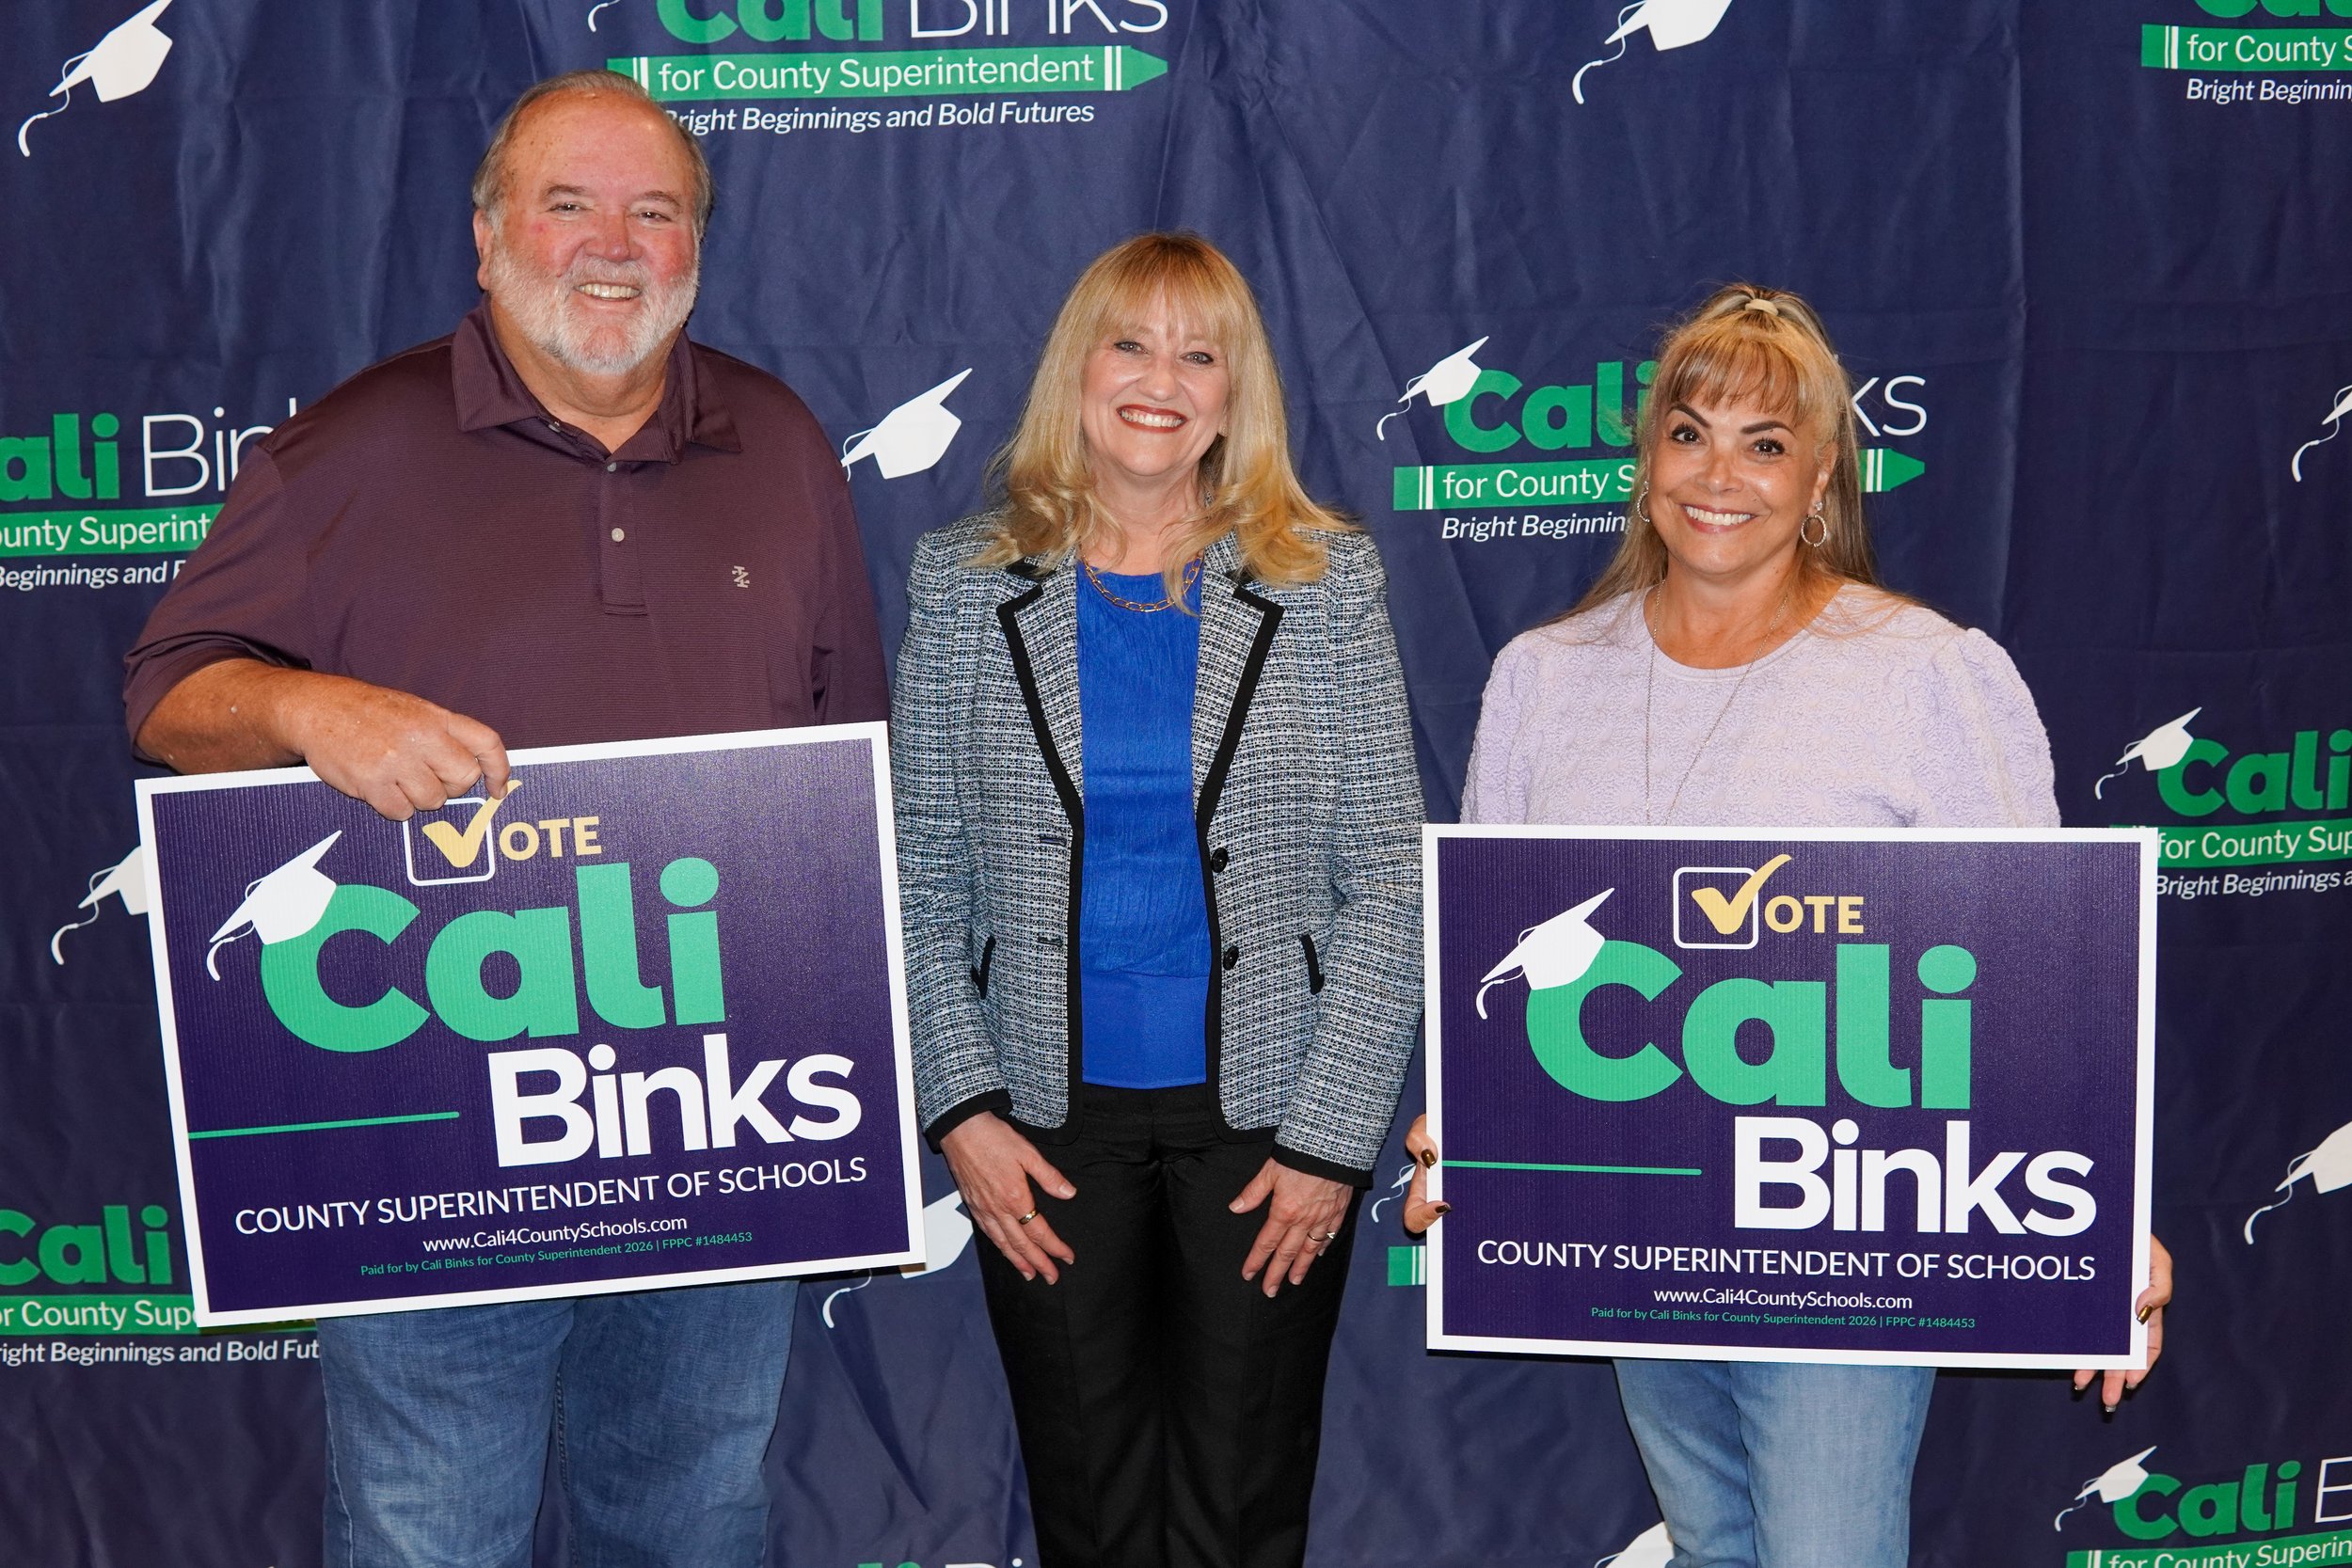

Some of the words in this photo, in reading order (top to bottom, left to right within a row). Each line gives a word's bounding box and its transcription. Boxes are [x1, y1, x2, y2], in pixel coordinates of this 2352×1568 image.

[2186, 34, 2228, 61] for
[2235, 35, 2337, 67] County
[659, 63, 705, 91] for
[713, 60, 831, 94] County
[840, 54, 1094, 92] Superintendent
[2186, 78, 2255, 104] Bright
[2259, 79, 2352, 104] Beginnin
[742, 107, 881, 134] Beginnings
[886, 104, 932, 127] and
[938, 103, 994, 125] Bold
[1000, 102, 1094, 123] Futures
[1442, 472, 1488, 499] for
[1496, 469, 1609, 499] County
[0, 519, 72, 551] unty
[1441, 516, 1516, 543] Bright
[1521, 512, 1632, 540] Beginnin
[123, 561, 167, 584] and
[2157, 729, 2352, 816] Cali
[2157, 832, 2196, 859] for
[2201, 829, 2301, 858] County
[2223, 869, 2341, 896] Beginnings
[261, 857, 725, 1053] Cali
[1526, 940, 1977, 1109] Cali
[488, 1033, 863, 1168] Binks
[1734, 1117, 2097, 1237] Binks
[235, 1200, 371, 1235] COUNTY
[377, 1175, 660, 1224] SUPERINTENDENT
[667, 1170, 710, 1198] OF
[719, 1157, 866, 1194] SCHOOLS
[422, 1217, 688, 1252] www.Cali4CountySchools.com
[360, 1264, 384, 1275] Paid
[388, 1263, 402, 1274] for
[405, 1261, 419, 1274] by
[421, 1259, 441, 1271] Cali
[445, 1258, 474, 1269] Binks
[477, 1255, 493, 1265] for
[496, 1252, 534, 1266] County
[537, 1244, 622, 1262] Superintendent
[625, 1241, 653, 1253] 2026
[662, 1237, 692, 1249] FPPC
[695, 1231, 753, 1246] #1484453
[1477, 1240, 1608, 1268] COUNTY
[1613, 1244, 1890, 1276] SUPERINTENDENT
[1897, 1253, 1940, 1277] OF
[1947, 1254, 2095, 1280] SCHOOLS
[1654, 1287, 1913, 1309] www.Cali4CountySchools.com
[22, 1301, 127, 1330] County
[135, 1300, 196, 1330] Sup
[1591, 1307, 1613, 1318] Paid
[1617, 1308, 1631, 1318] for
[1634, 1308, 1647, 1321] by
[1649, 1309, 1669, 1320] Cali
[1673, 1310, 1701, 1321] Binks
[1704, 1311, 1719, 1321] for
[1722, 1312, 1760, 1324] County
[1763, 1313, 1845, 1325] Superintendent
[1849, 1316, 1877, 1325] 2026
[1885, 1317, 1915, 1326] FPPC
[1918, 1317, 1975, 1328] #1484453
[0, 1343, 46, 1367] ight
[51, 1342, 174, 1366] Beginnings
[179, 1341, 221, 1362] and
[227, 1340, 278, 1362] Bold
[2113, 1461, 2301, 1540] Cali
